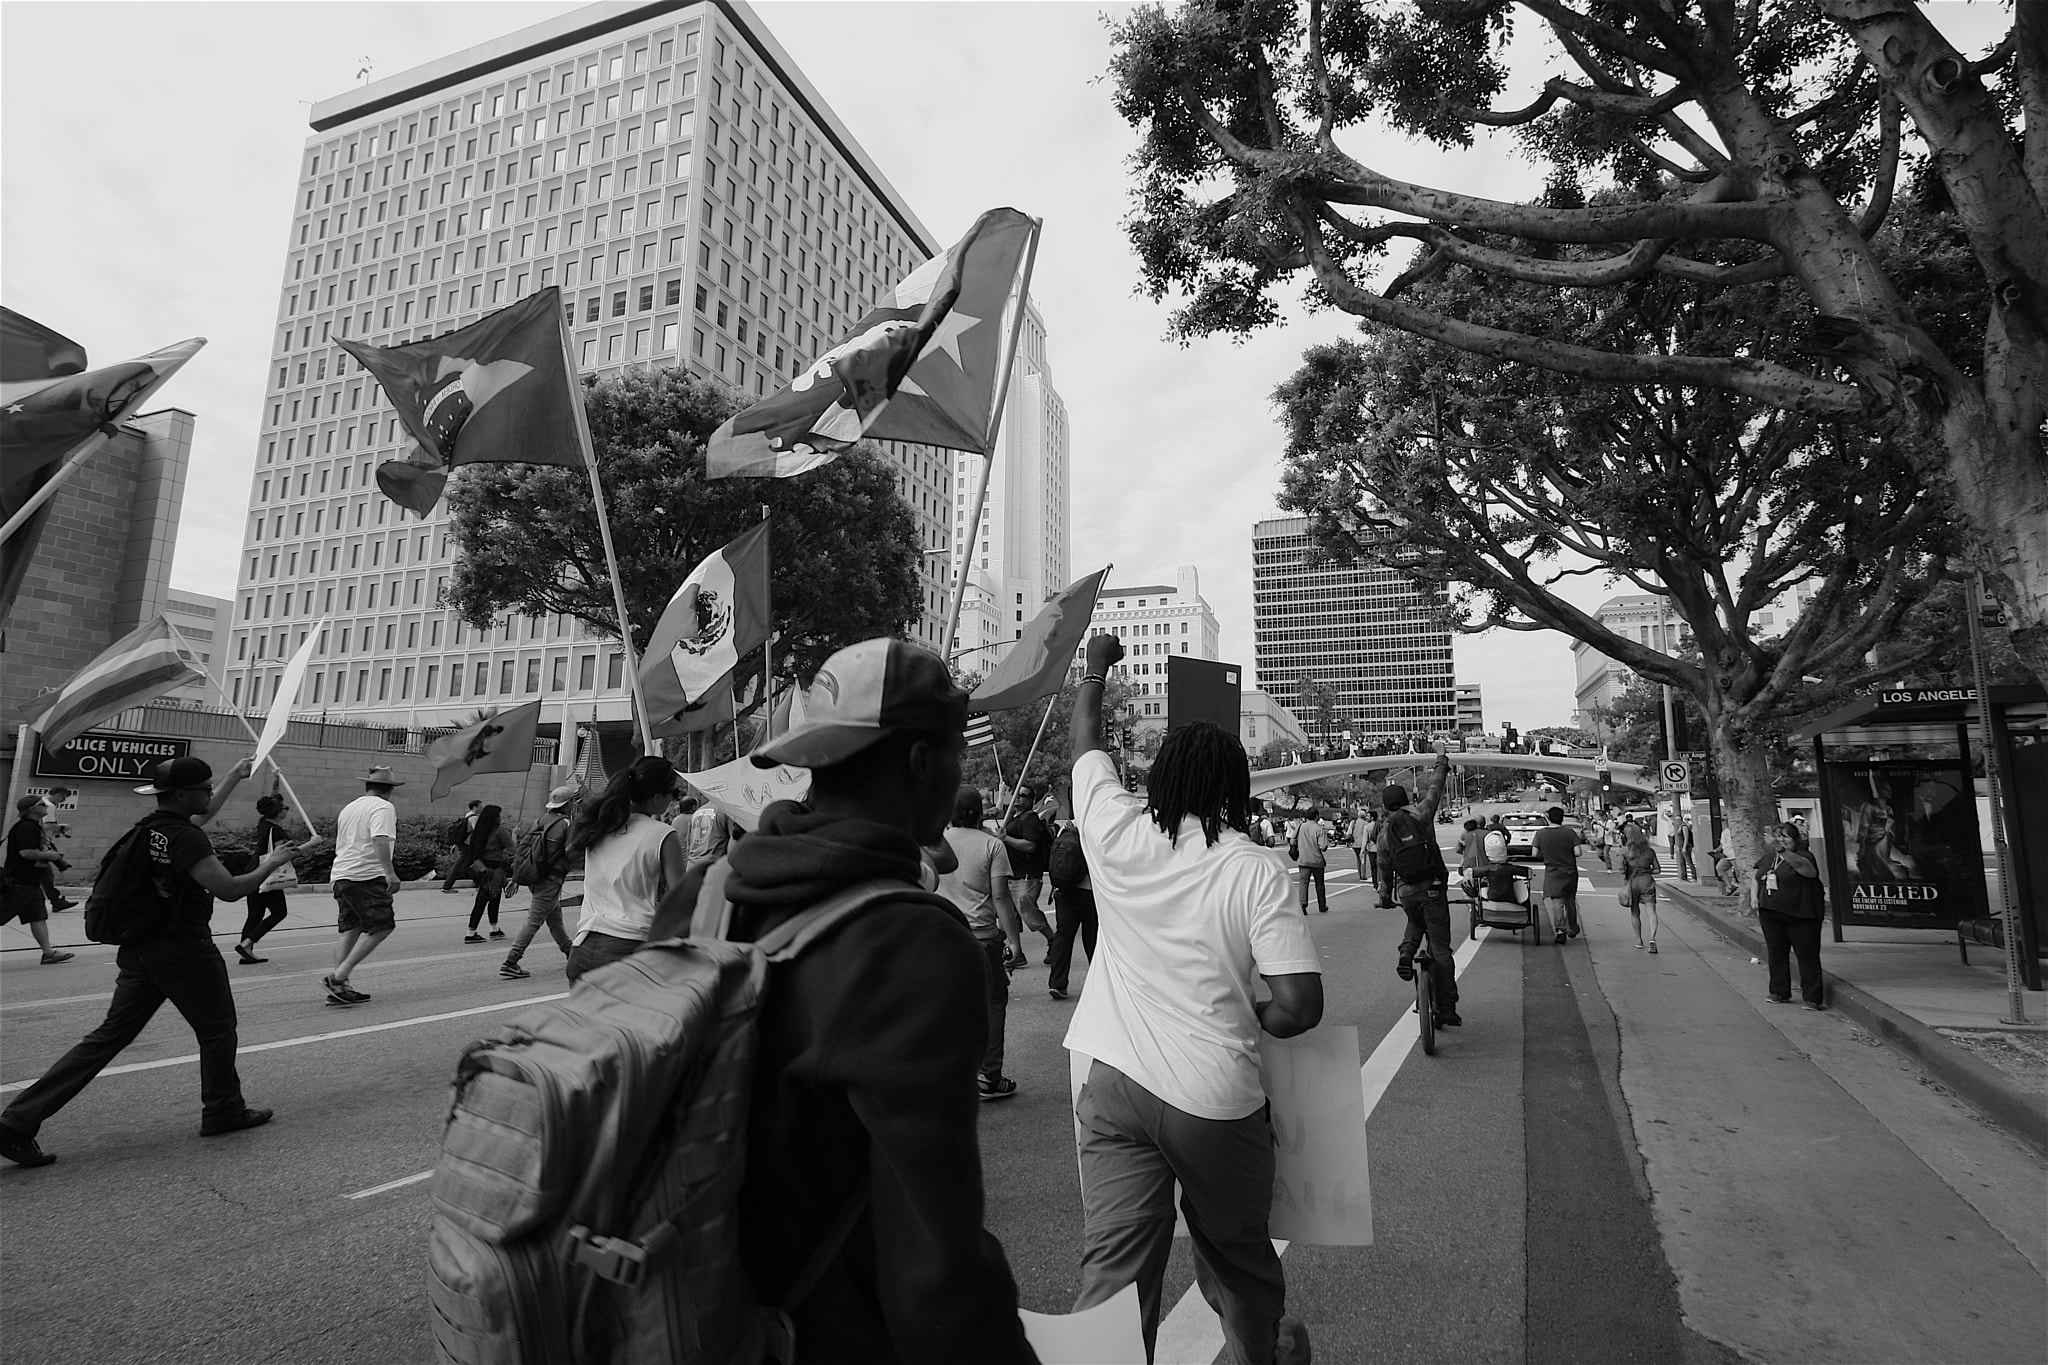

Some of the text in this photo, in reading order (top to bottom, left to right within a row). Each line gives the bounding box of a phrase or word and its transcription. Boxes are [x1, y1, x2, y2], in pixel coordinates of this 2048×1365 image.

[1883, 689, 1978, 703] LOS ANGELE
[65, 738, 176, 756] OLICE VEHICLES
[78, 755, 150, 775] ONLY
[1853, 885, 1938, 900] ALLIED
